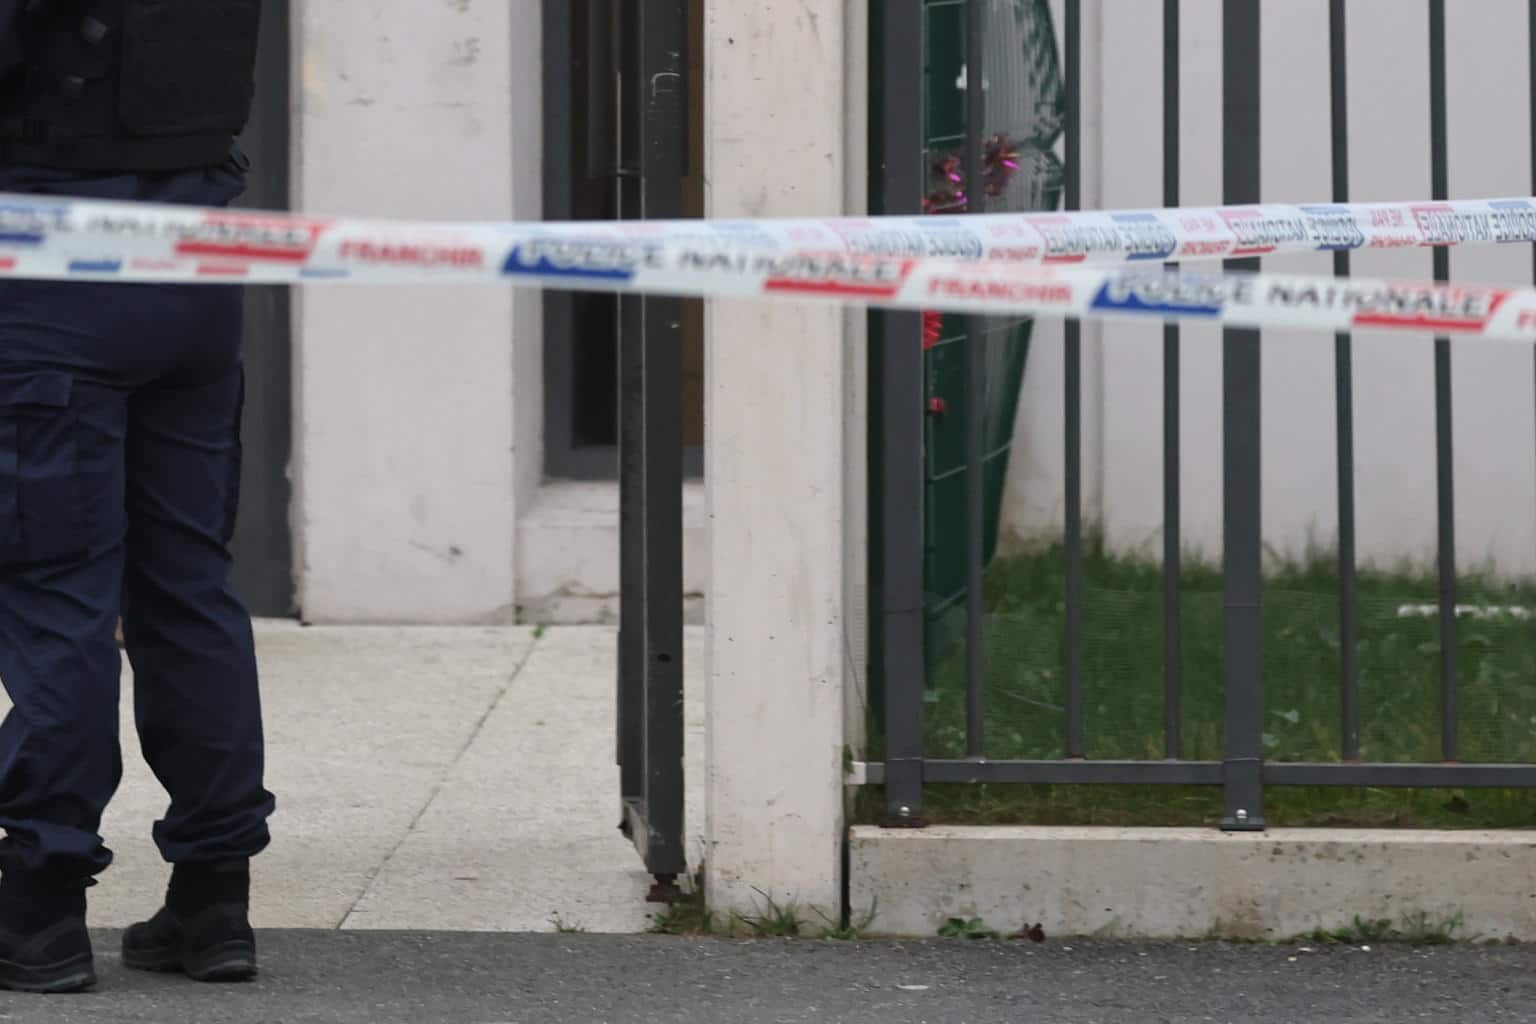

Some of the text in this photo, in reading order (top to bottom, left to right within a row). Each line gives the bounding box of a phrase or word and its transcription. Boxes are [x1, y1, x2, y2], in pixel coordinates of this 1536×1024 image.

[339, 241, 484, 267] FRANCHIR
[524, 238, 664, 270] POLICE
[928, 278, 1073, 302] FRANCHIR
[1112, 272, 1484, 318] POLICE NATIONALE
